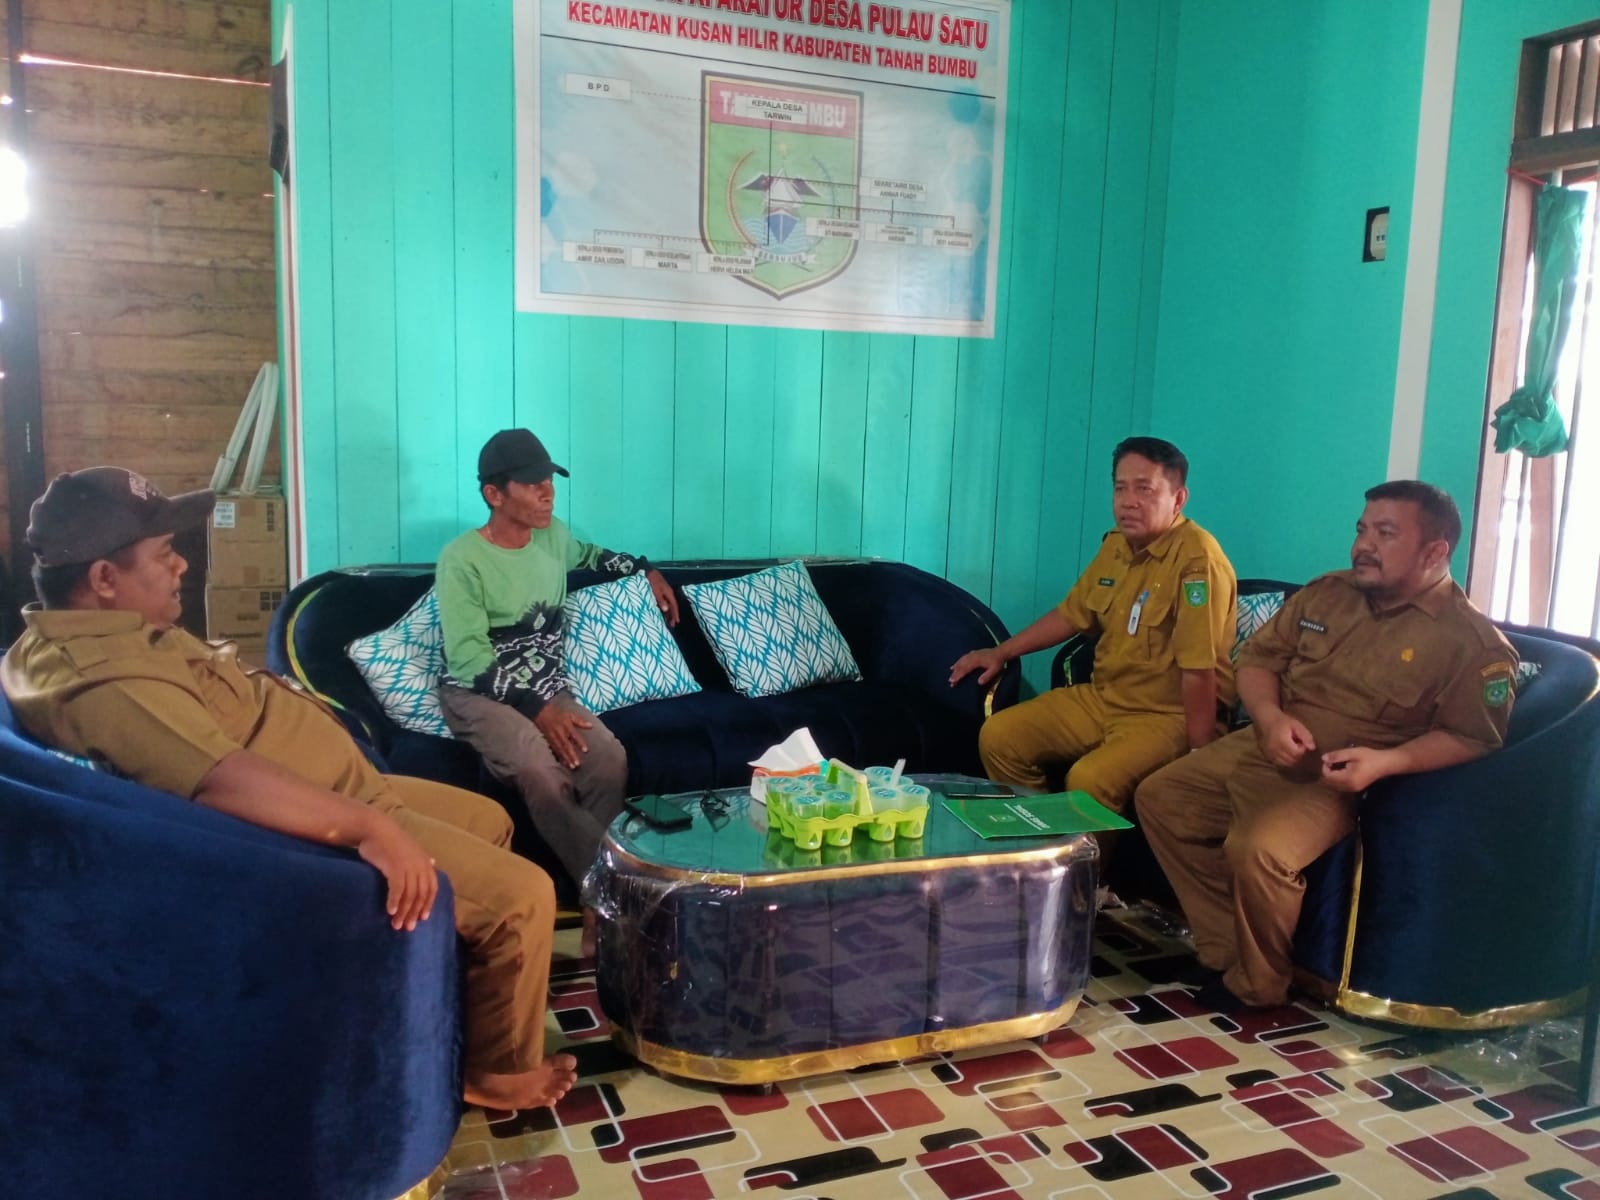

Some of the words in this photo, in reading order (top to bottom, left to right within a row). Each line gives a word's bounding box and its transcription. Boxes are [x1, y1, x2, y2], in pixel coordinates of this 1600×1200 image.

[567, 1, 672, 36] KECAMATAN
[676, 16, 732, 45] KUSAN
[737, 26, 779, 52] HILIR
[783, 33, 872, 65] KABUPATEN
[876, 47, 924, 72] TANAH
[928, 55, 977, 79] BUMBU
[809, 0, 863, 31] DESA
[868, 4, 934, 42] PULAU
[939, 14, 989, 50] SATU
[751, 99, 782, 110] KEPALA
[783, 103, 803, 112] DESA
